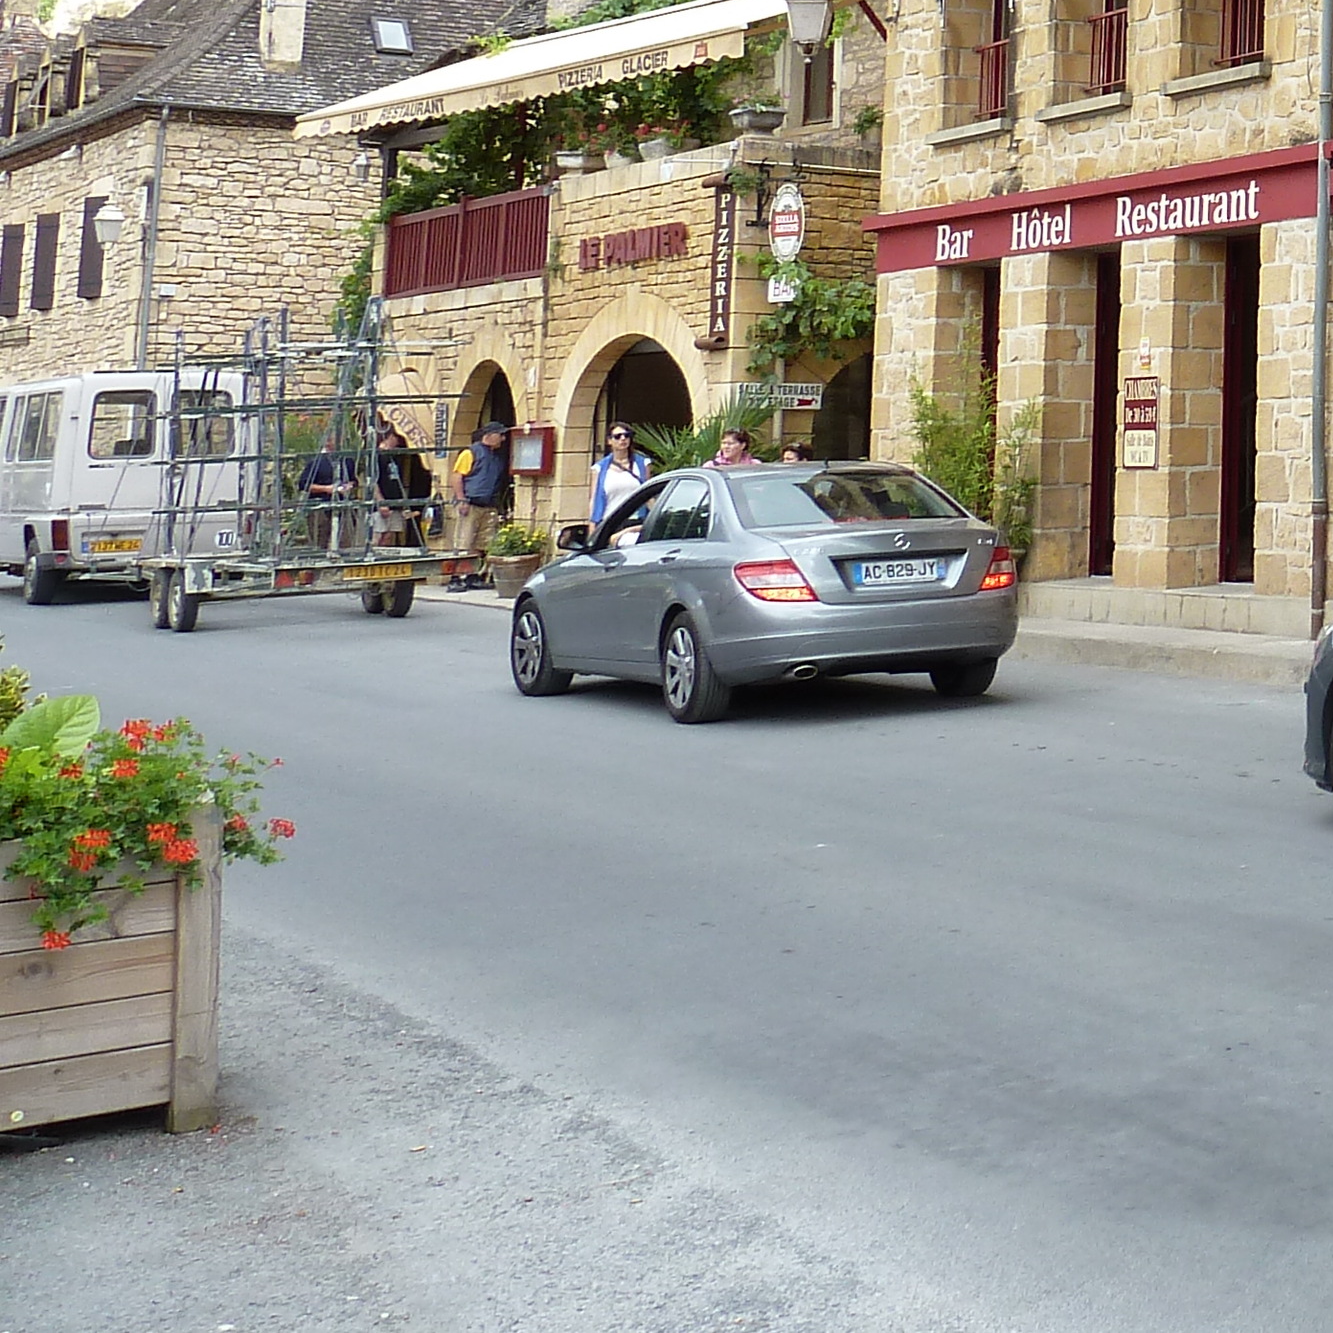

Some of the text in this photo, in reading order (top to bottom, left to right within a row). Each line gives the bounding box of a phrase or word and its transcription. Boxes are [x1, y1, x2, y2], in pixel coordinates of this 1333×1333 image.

[350, 50, 669, 127] BAR RESTAURANT PIZZERIA GLACIER
[578, 221, 690, 272] LE PALMIER
[934, 179, 1260, 262] Bar Hôtel Restaurant
[712, 192, 732, 333] PIZZERIA
[863, 561, 937, 580] AC-829-JY
